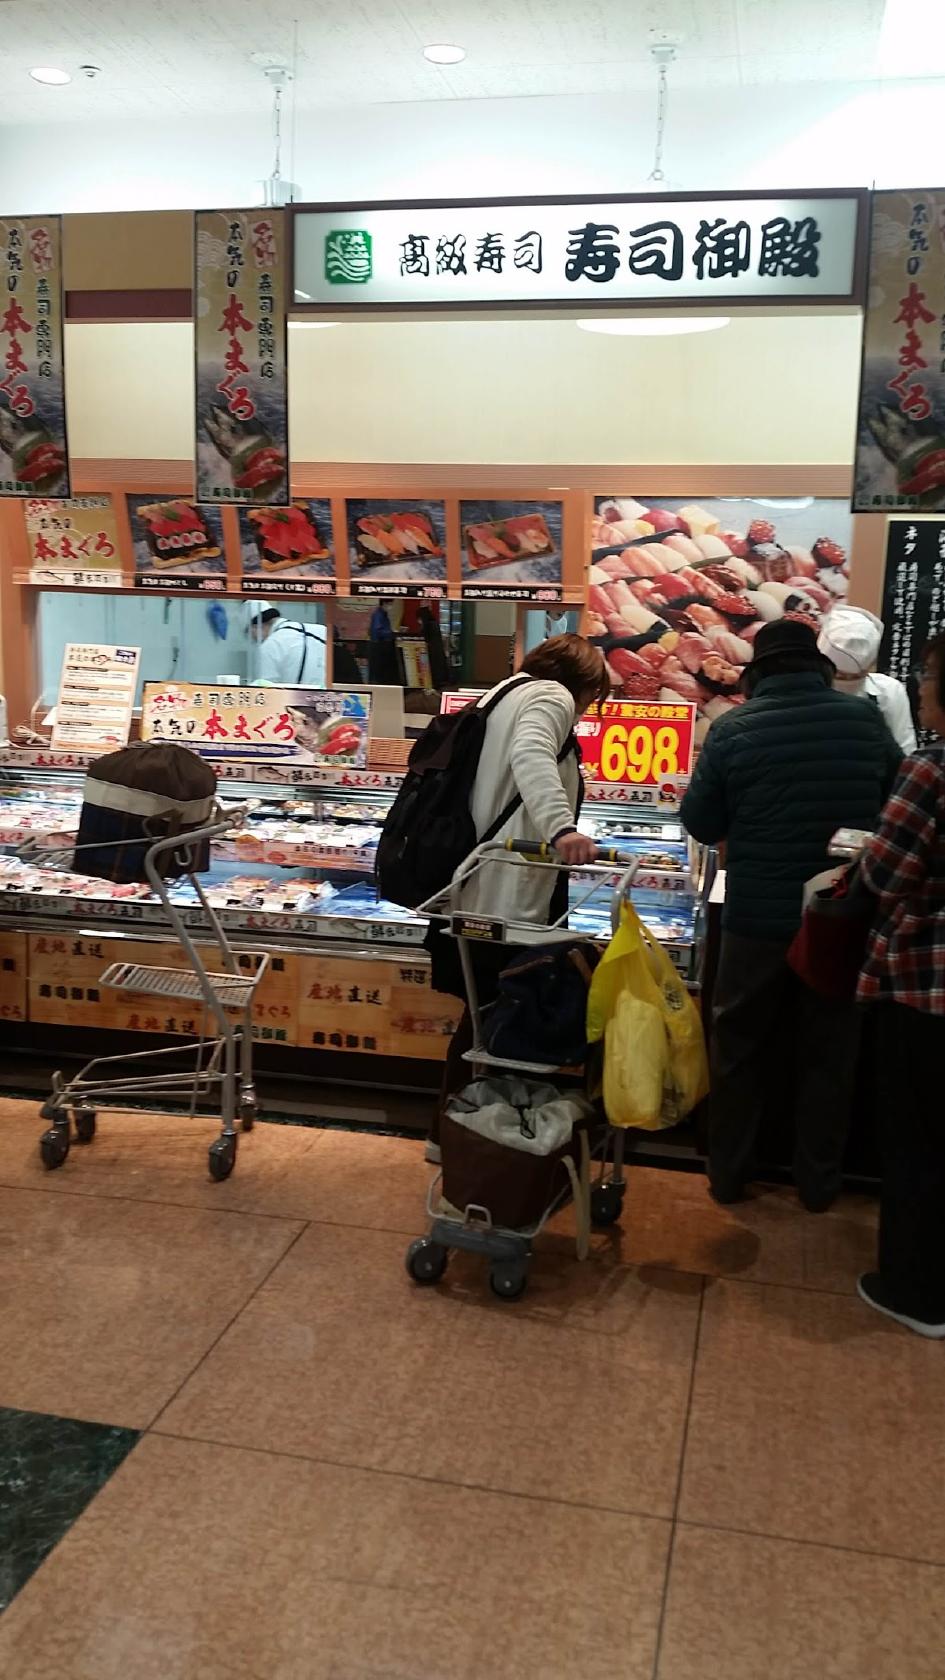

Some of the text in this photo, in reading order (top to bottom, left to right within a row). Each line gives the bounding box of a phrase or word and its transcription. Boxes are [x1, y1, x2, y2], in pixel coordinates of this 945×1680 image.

[565, 216, 821, 282] 寿司御殿
[601, 723, 680, 782] 698
[35, 936, 105, 959] 産地直送
[307, 981, 383, 1006] 産地直送
[127, 1012, 197, 1035] 産地直送
